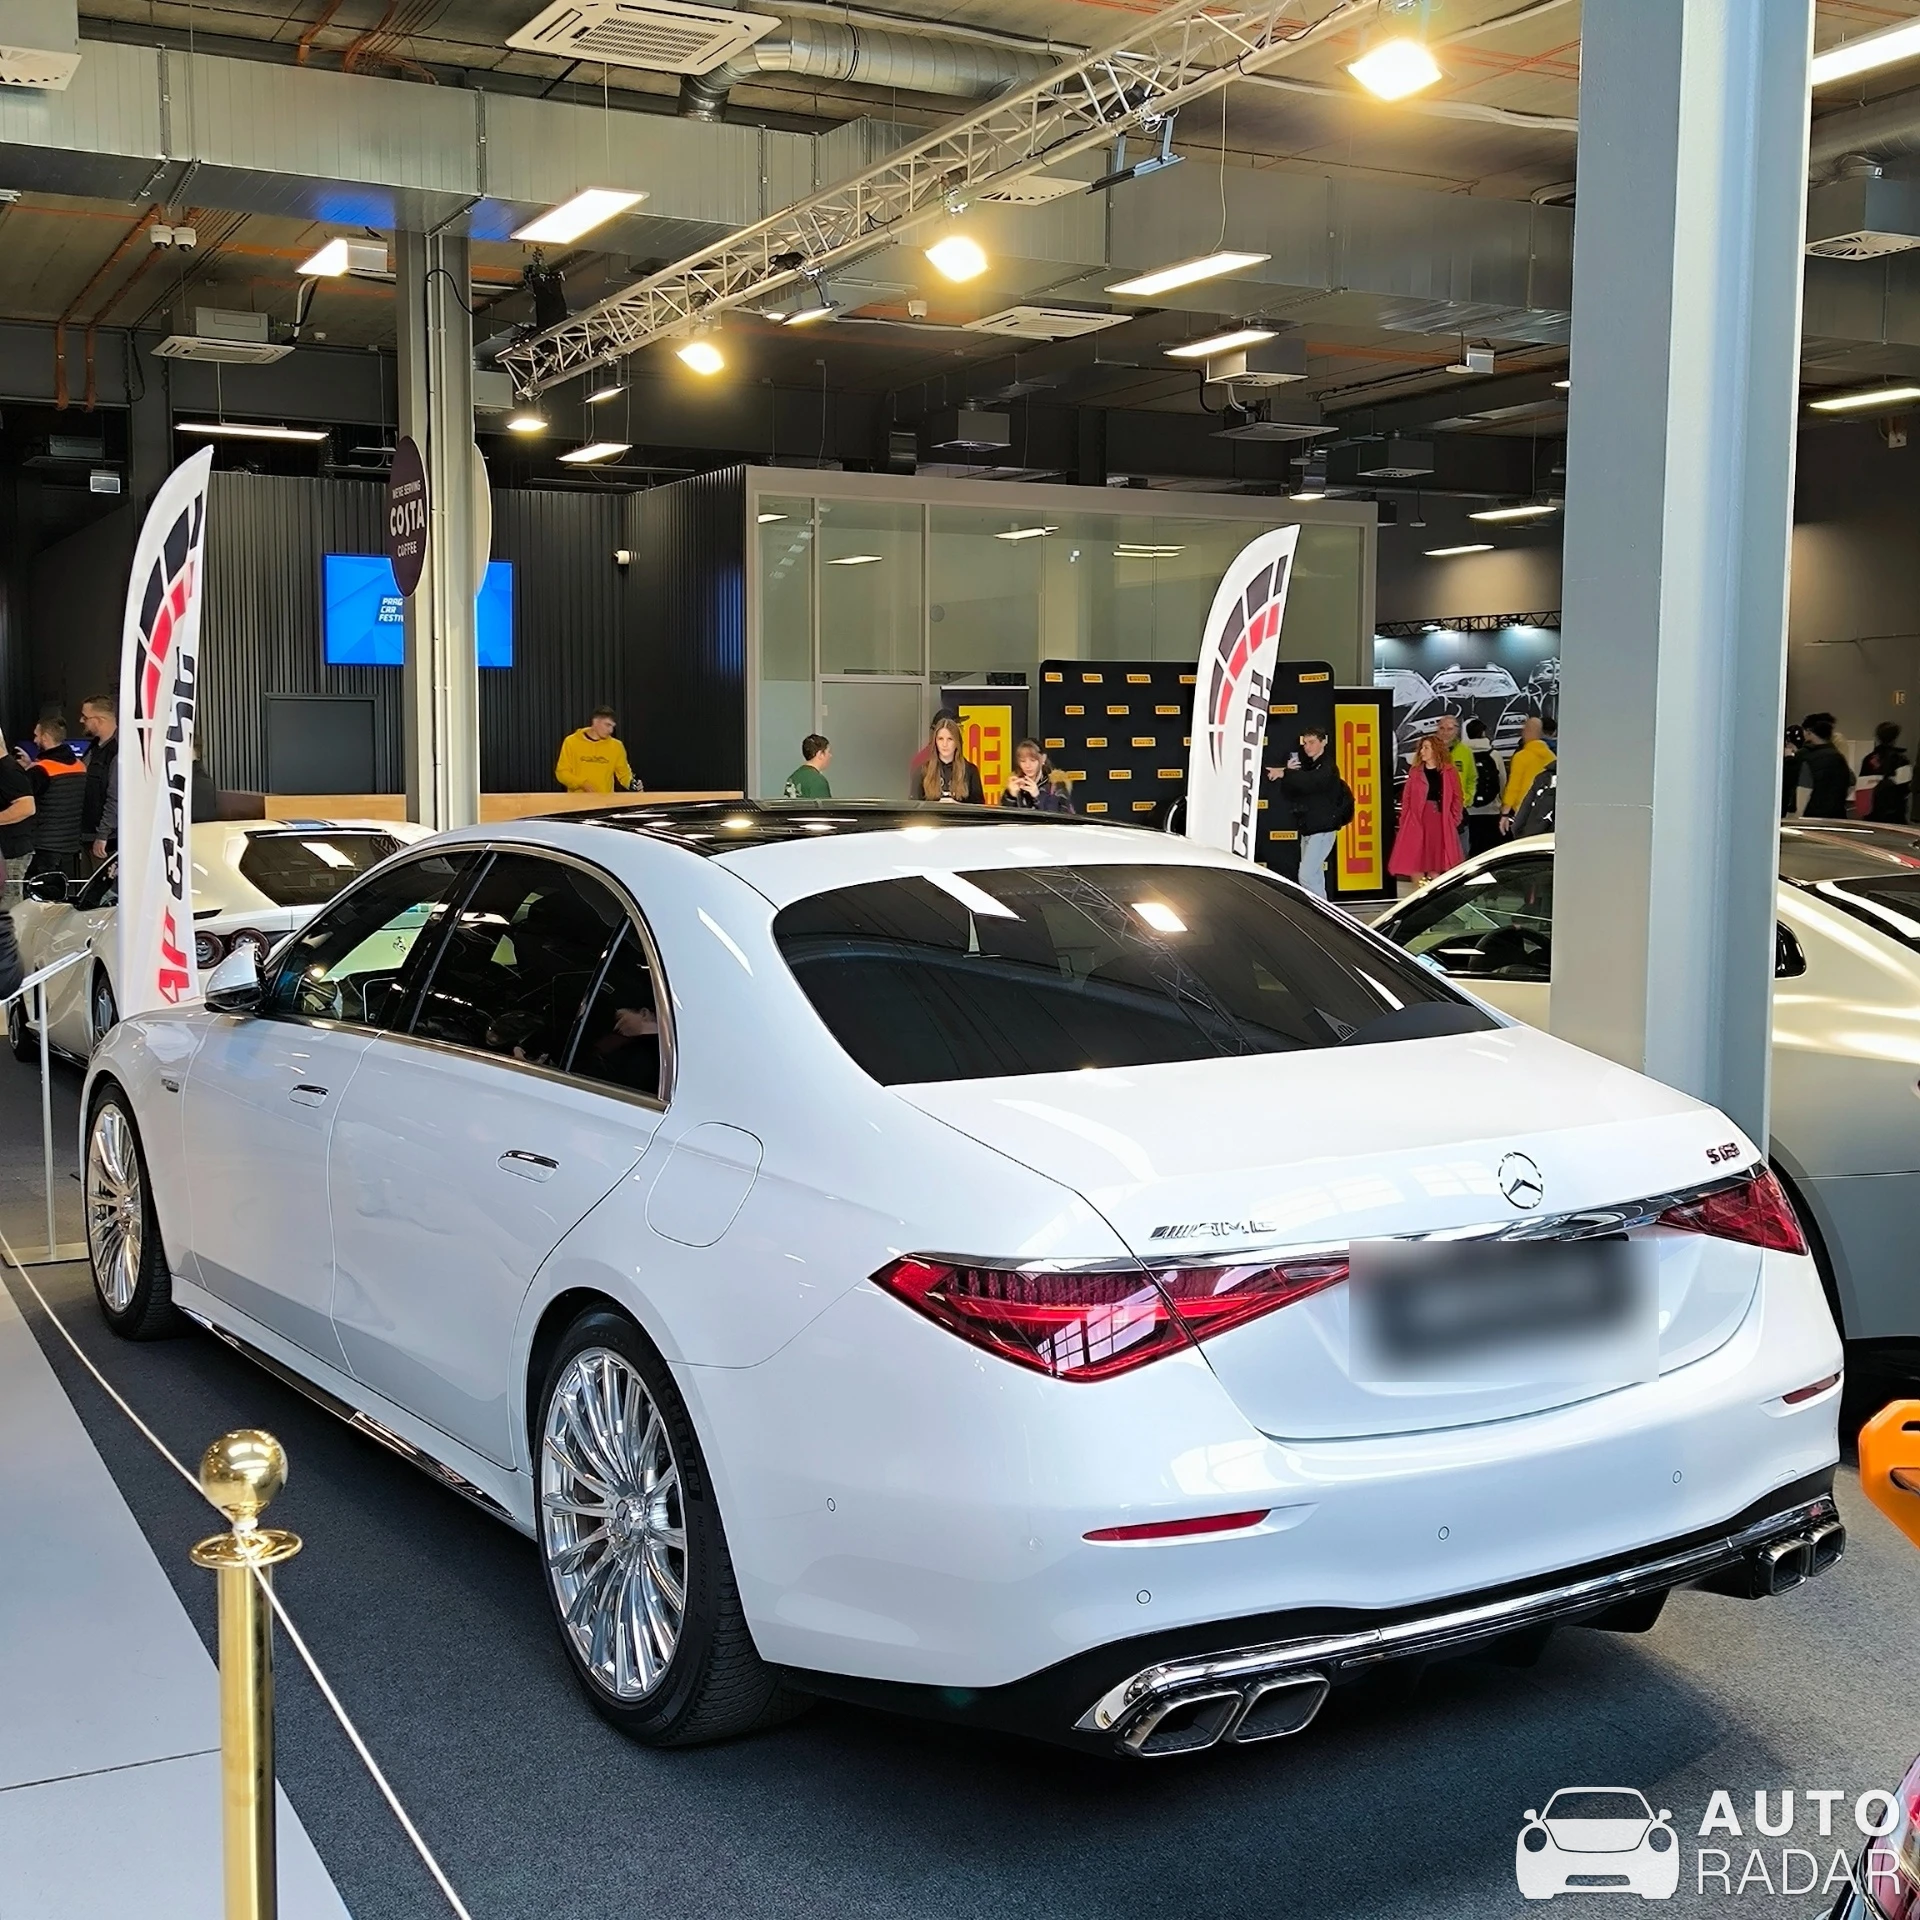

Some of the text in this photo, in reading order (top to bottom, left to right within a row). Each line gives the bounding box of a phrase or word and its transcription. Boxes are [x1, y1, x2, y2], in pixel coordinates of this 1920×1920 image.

[403, 480, 421, 496] SERVING
[389, 499, 425, 537] COSTA
[397, 541, 418, 557] COFFEE
[380, 606, 397, 614] CAR
[1344, 721, 1374, 874] PIRELLI
[159, 905, 190, 1004] AP
[1194, 1220, 1278, 1238] AMG
[651, 1357, 702, 1494] MICHELIN
